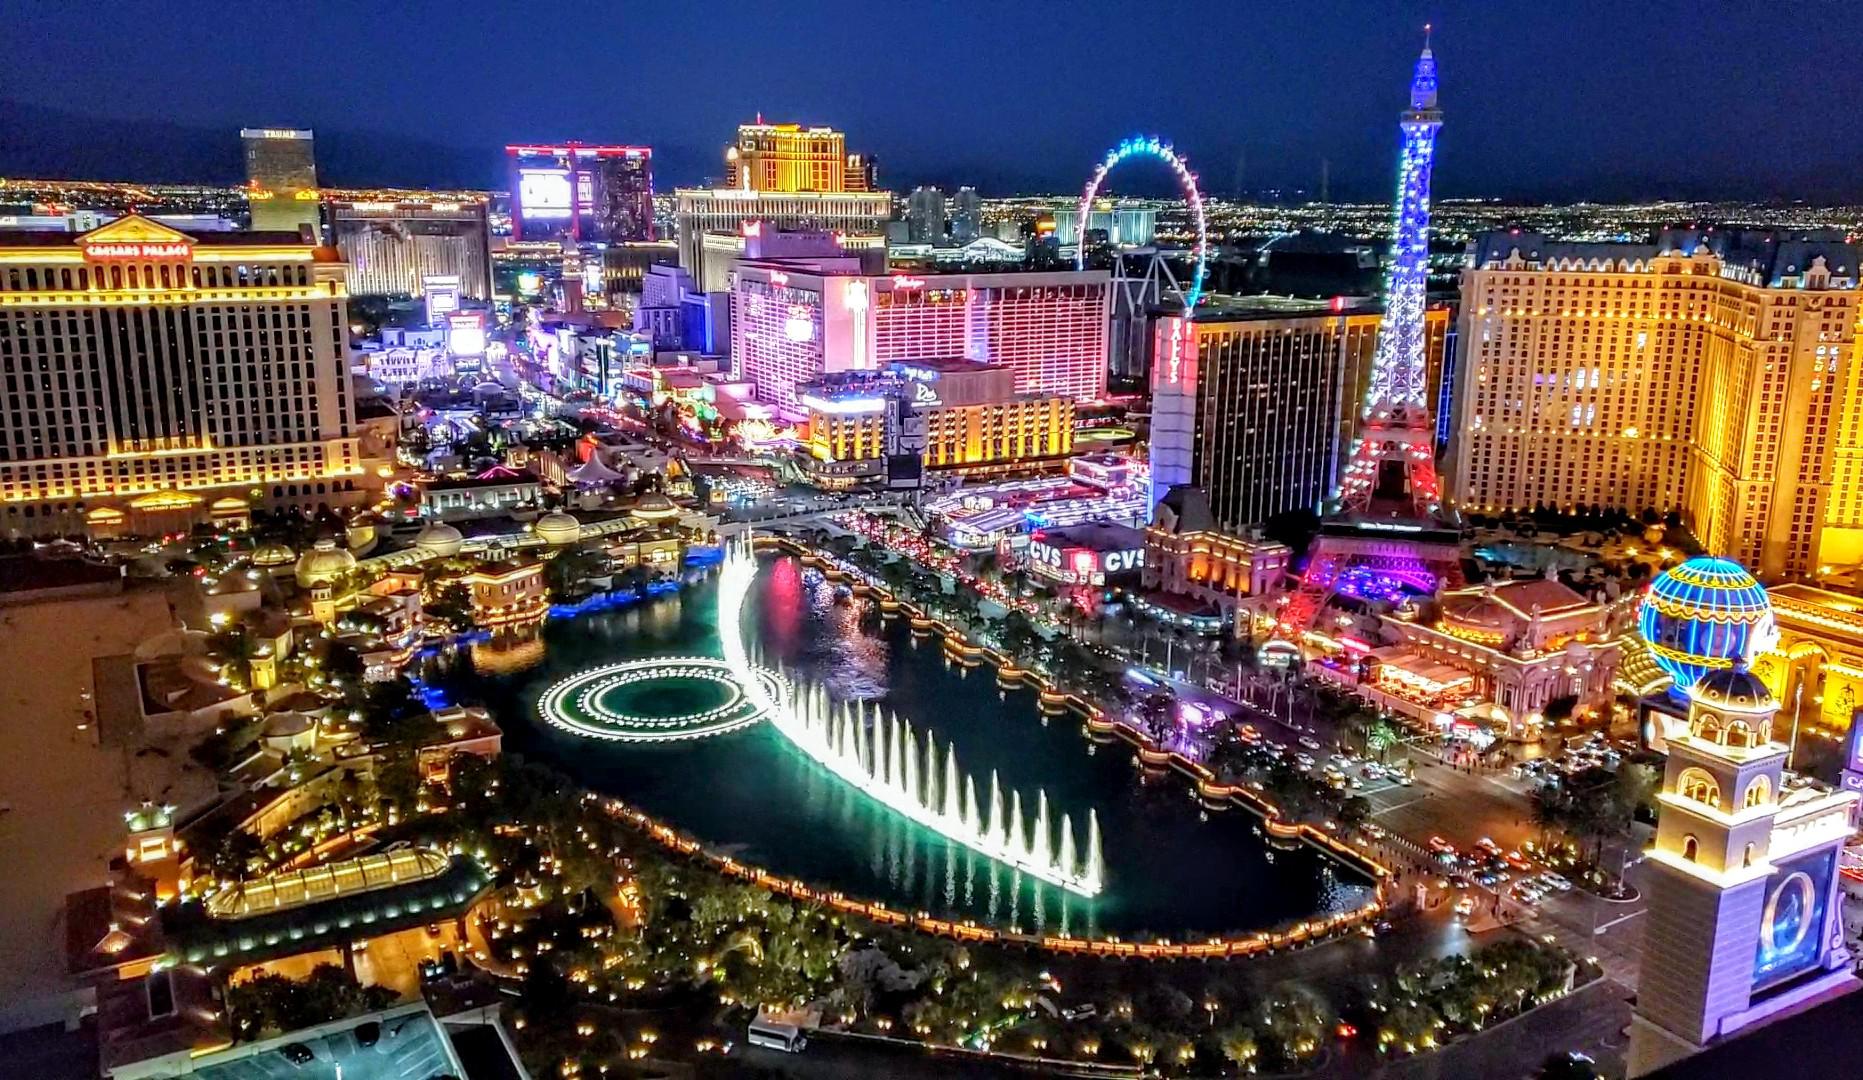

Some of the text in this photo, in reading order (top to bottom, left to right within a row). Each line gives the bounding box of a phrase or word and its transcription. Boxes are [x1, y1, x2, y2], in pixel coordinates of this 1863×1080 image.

[263, 129, 297, 139] TRUMP
[86, 245, 189, 257] CAESARS PALACE
[1030, 540, 1062, 567] CVS
[1105, 548, 1145, 572] CVS
